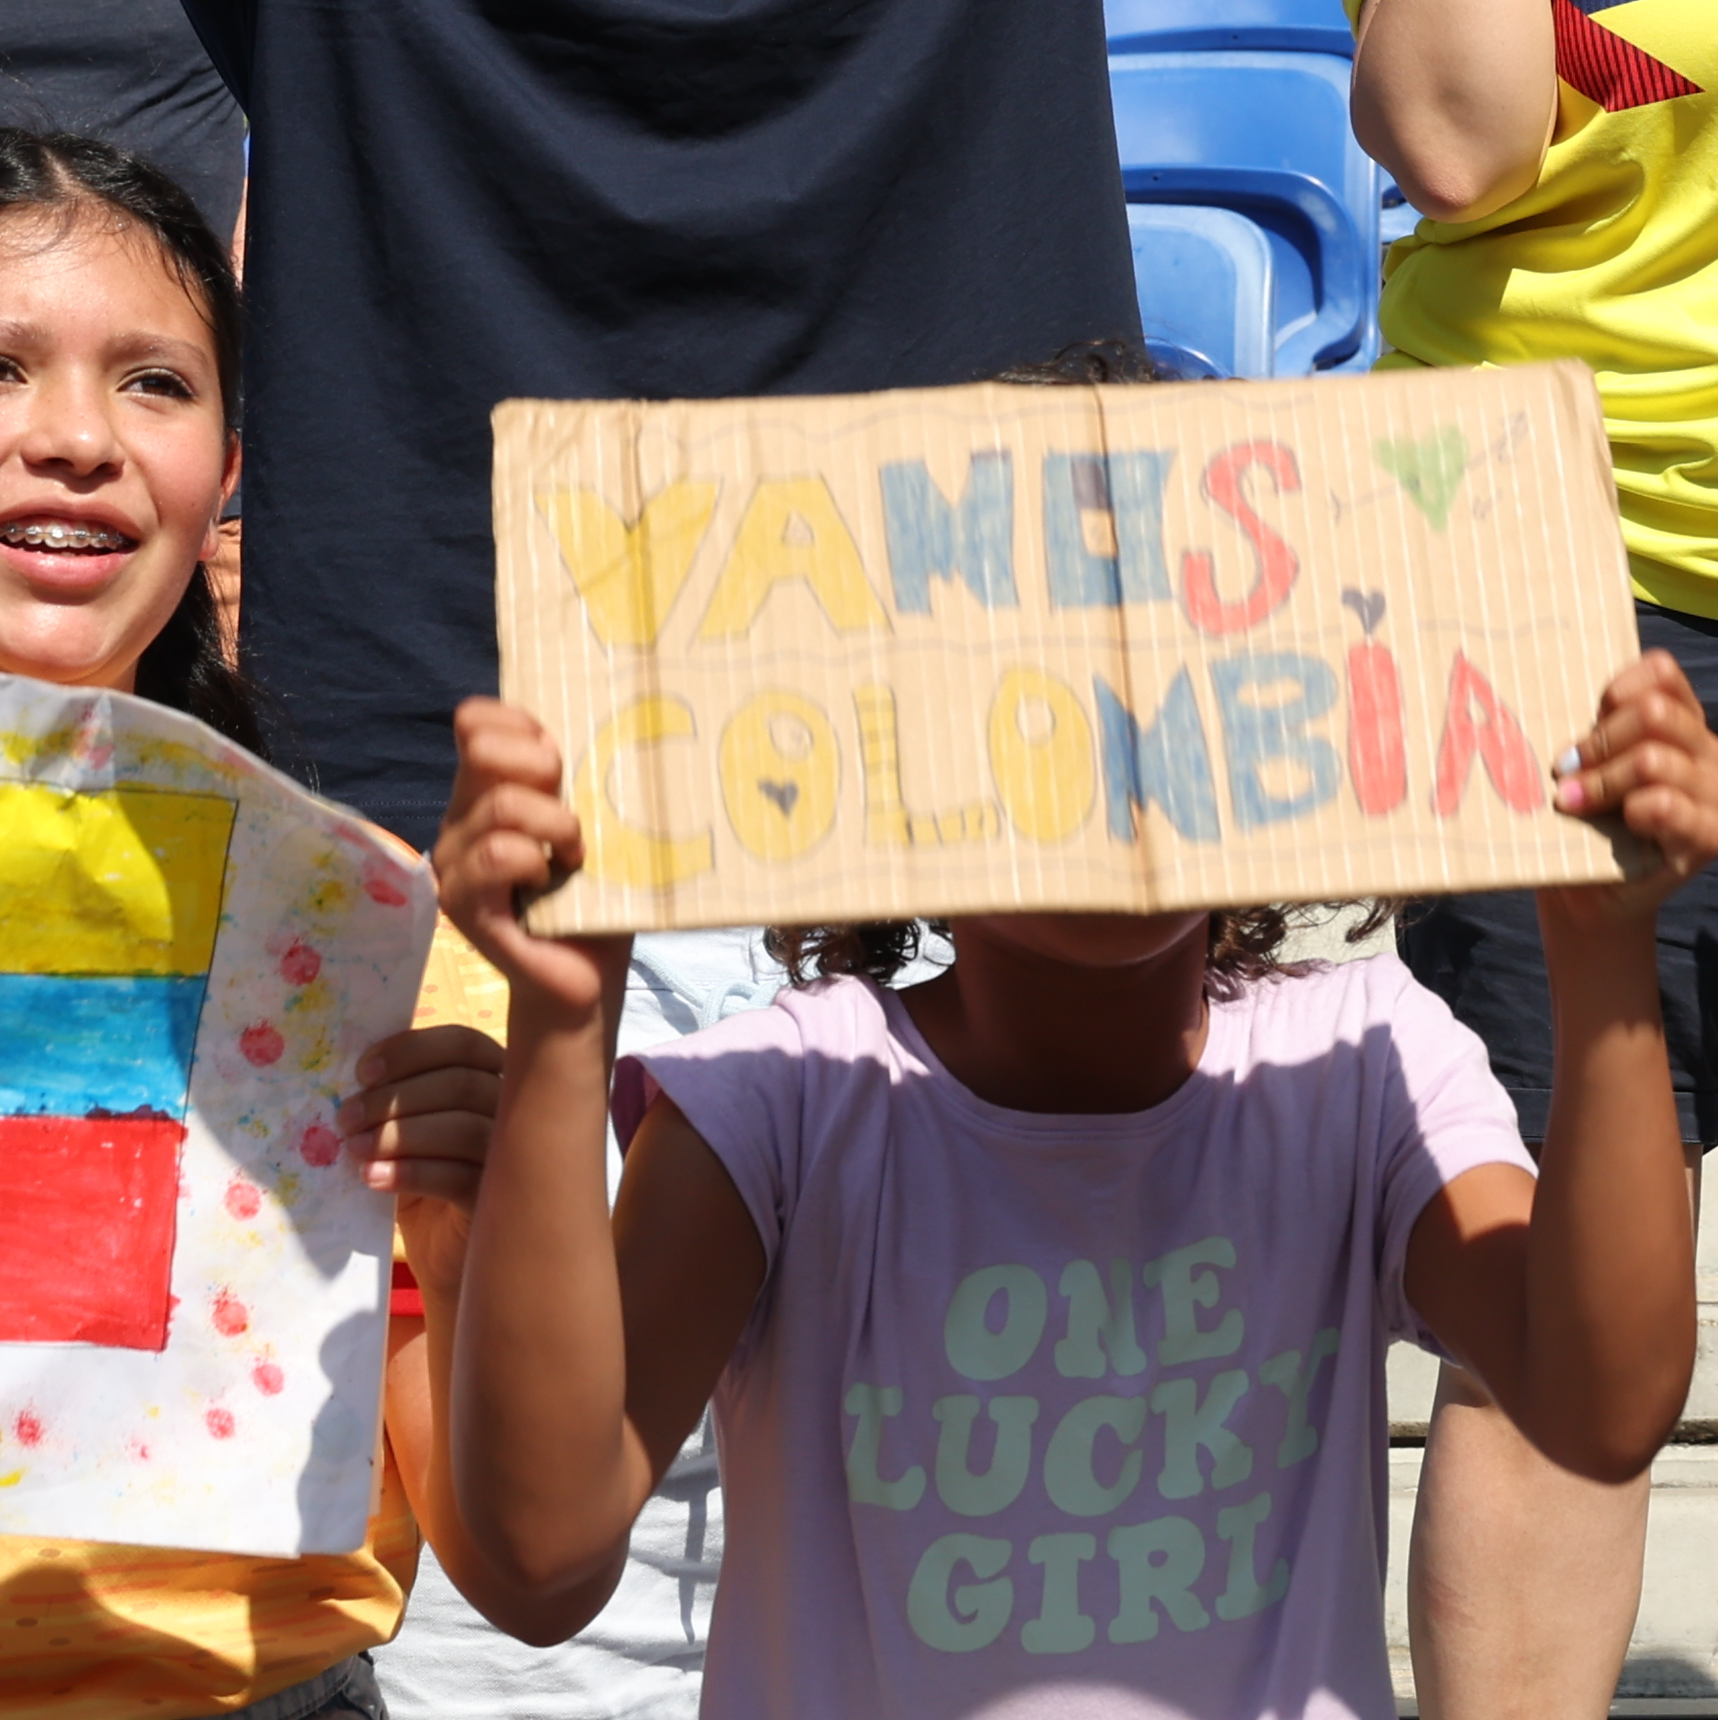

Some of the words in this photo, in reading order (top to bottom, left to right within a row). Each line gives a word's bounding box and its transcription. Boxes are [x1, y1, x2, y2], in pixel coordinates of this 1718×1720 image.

[574, 620, 1547, 885] COLOMBIA
[943, 1235, 1245, 1382] ONE
[843, 1326, 1341, 1518] LUCKY
[906, 1491, 1291, 1655] GIRL
